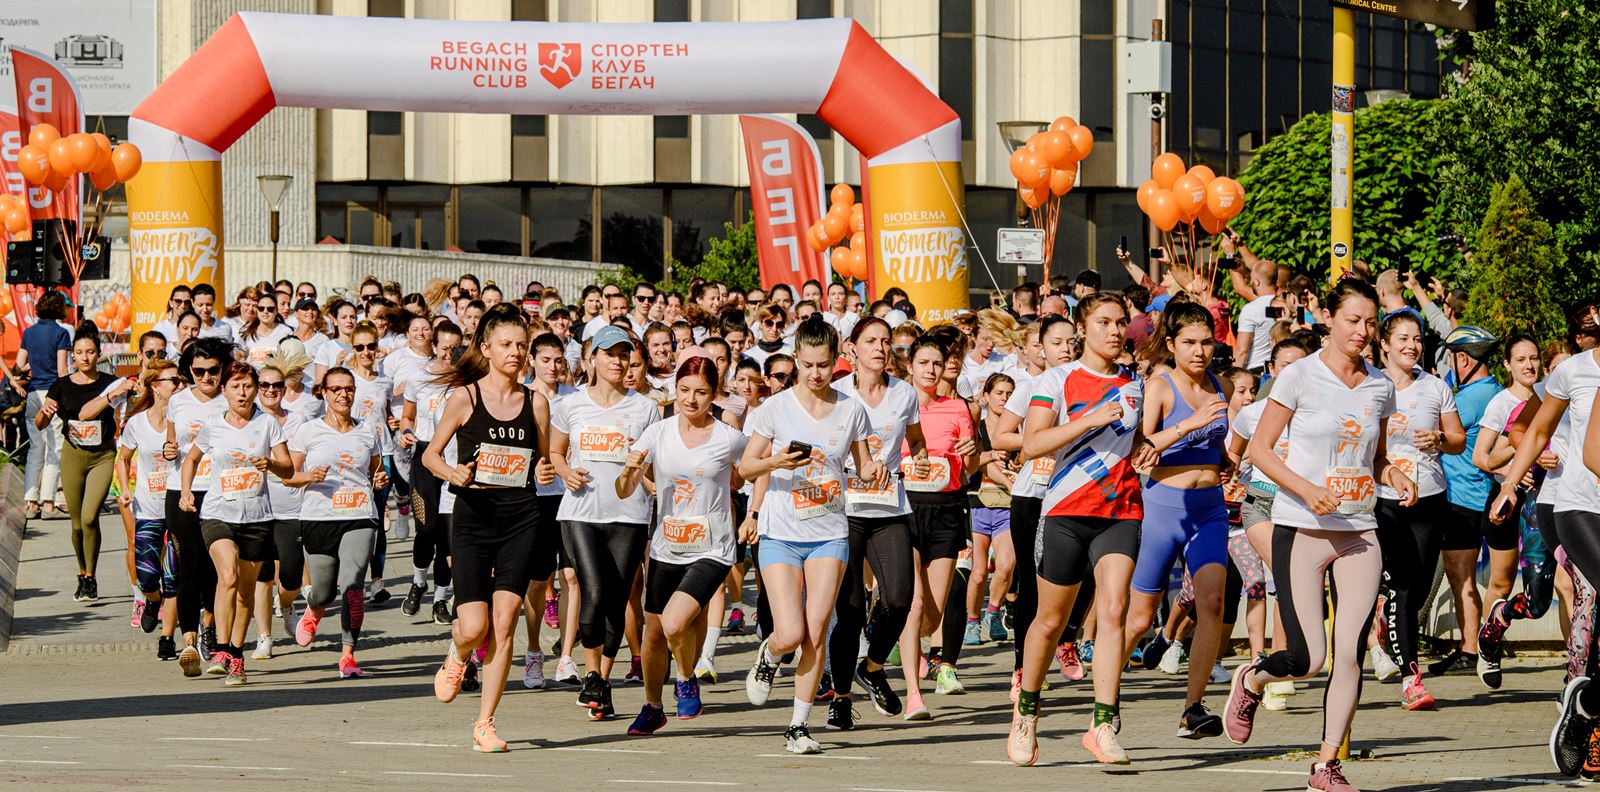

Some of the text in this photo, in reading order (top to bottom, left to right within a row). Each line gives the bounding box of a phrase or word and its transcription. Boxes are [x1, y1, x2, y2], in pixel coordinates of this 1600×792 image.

[442, 41, 527, 55] BEGACH
[591, 43, 689, 57] СПОРТЕН
[430, 56, 527, 72] RUNNING
[591, 60, 646, 74] КЛУБ
[473, 74, 527, 89] CLUB
[591, 76, 655, 90] БЕГАЧ
[132, 211, 189, 221] BIODERMA
[883, 210, 946, 223] BIODERMA
[135, 256, 181, 284] RUN
[889, 254, 940, 284] RUN
[488, 426, 525, 441] GOOD
[582, 433, 608, 446] 5004
[480, 453, 509, 468] 3008
[798, 484, 822, 502] 3119
[1329, 478, 1358, 494] 5304
[335, 494, 354, 504] 5118
[665, 523, 686, 538] 3007
